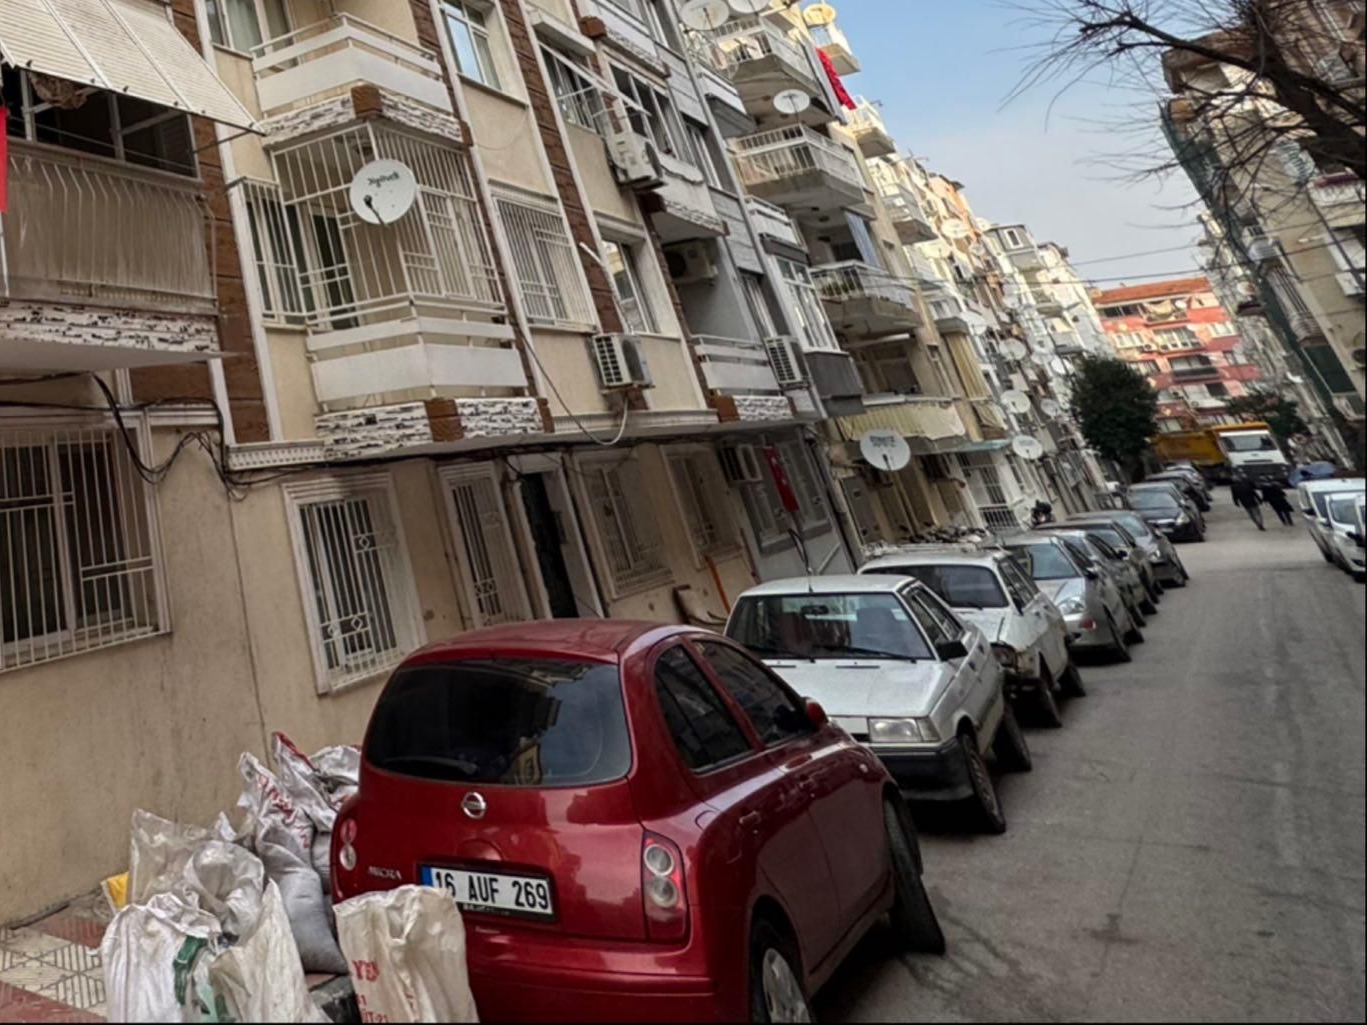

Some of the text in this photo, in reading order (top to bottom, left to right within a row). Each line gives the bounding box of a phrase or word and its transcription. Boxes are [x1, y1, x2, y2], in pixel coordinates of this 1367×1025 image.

[435, 871, 549, 910] 16 AUF 269
